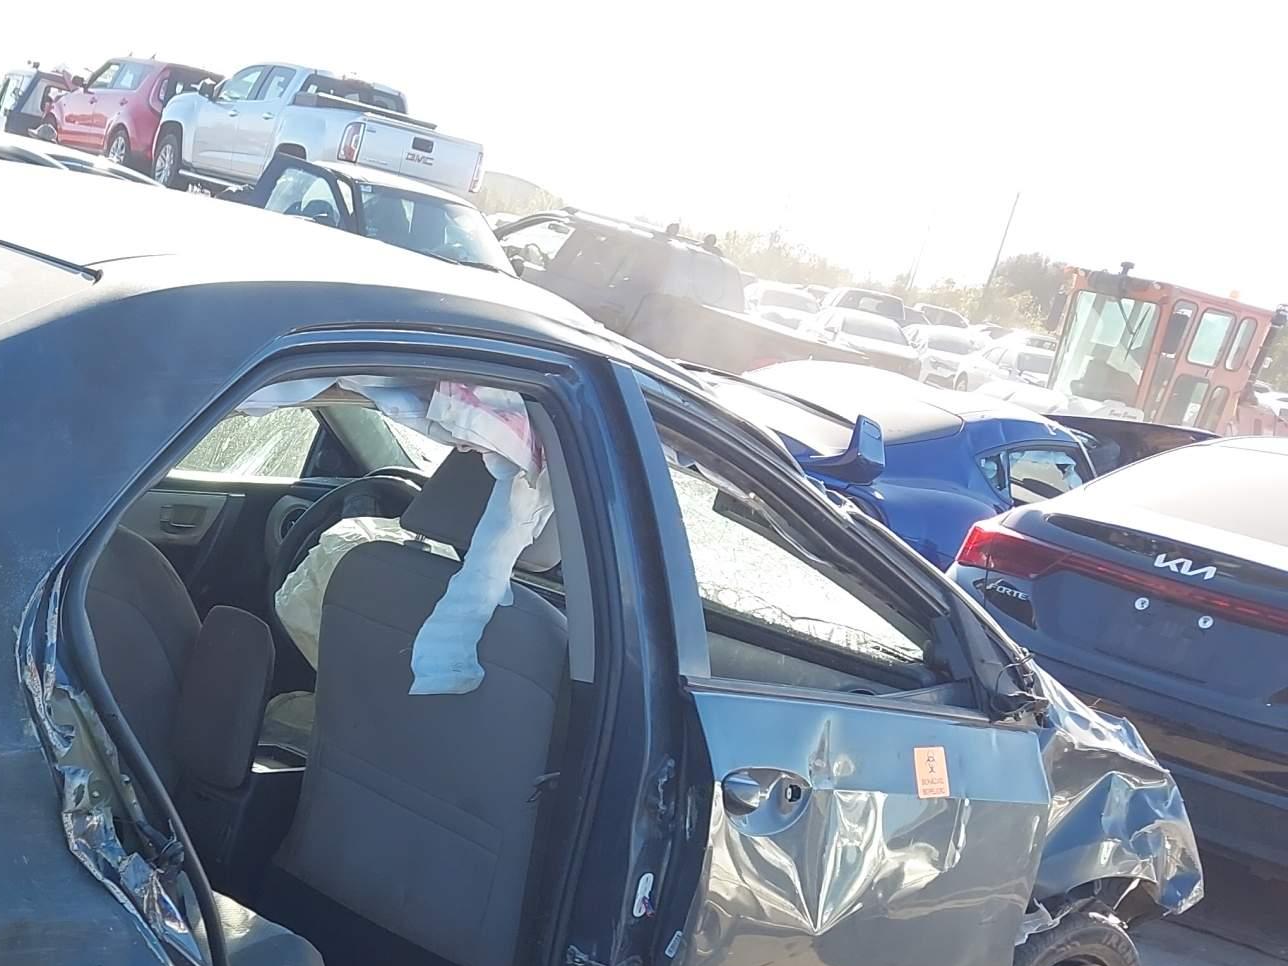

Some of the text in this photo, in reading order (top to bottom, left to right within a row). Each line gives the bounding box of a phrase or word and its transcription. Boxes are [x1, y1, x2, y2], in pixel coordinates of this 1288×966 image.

[406, 152, 434, 166] GMC
[1154, 553, 1217, 580] KIA
[987, 579, 1030, 601] FORTE
